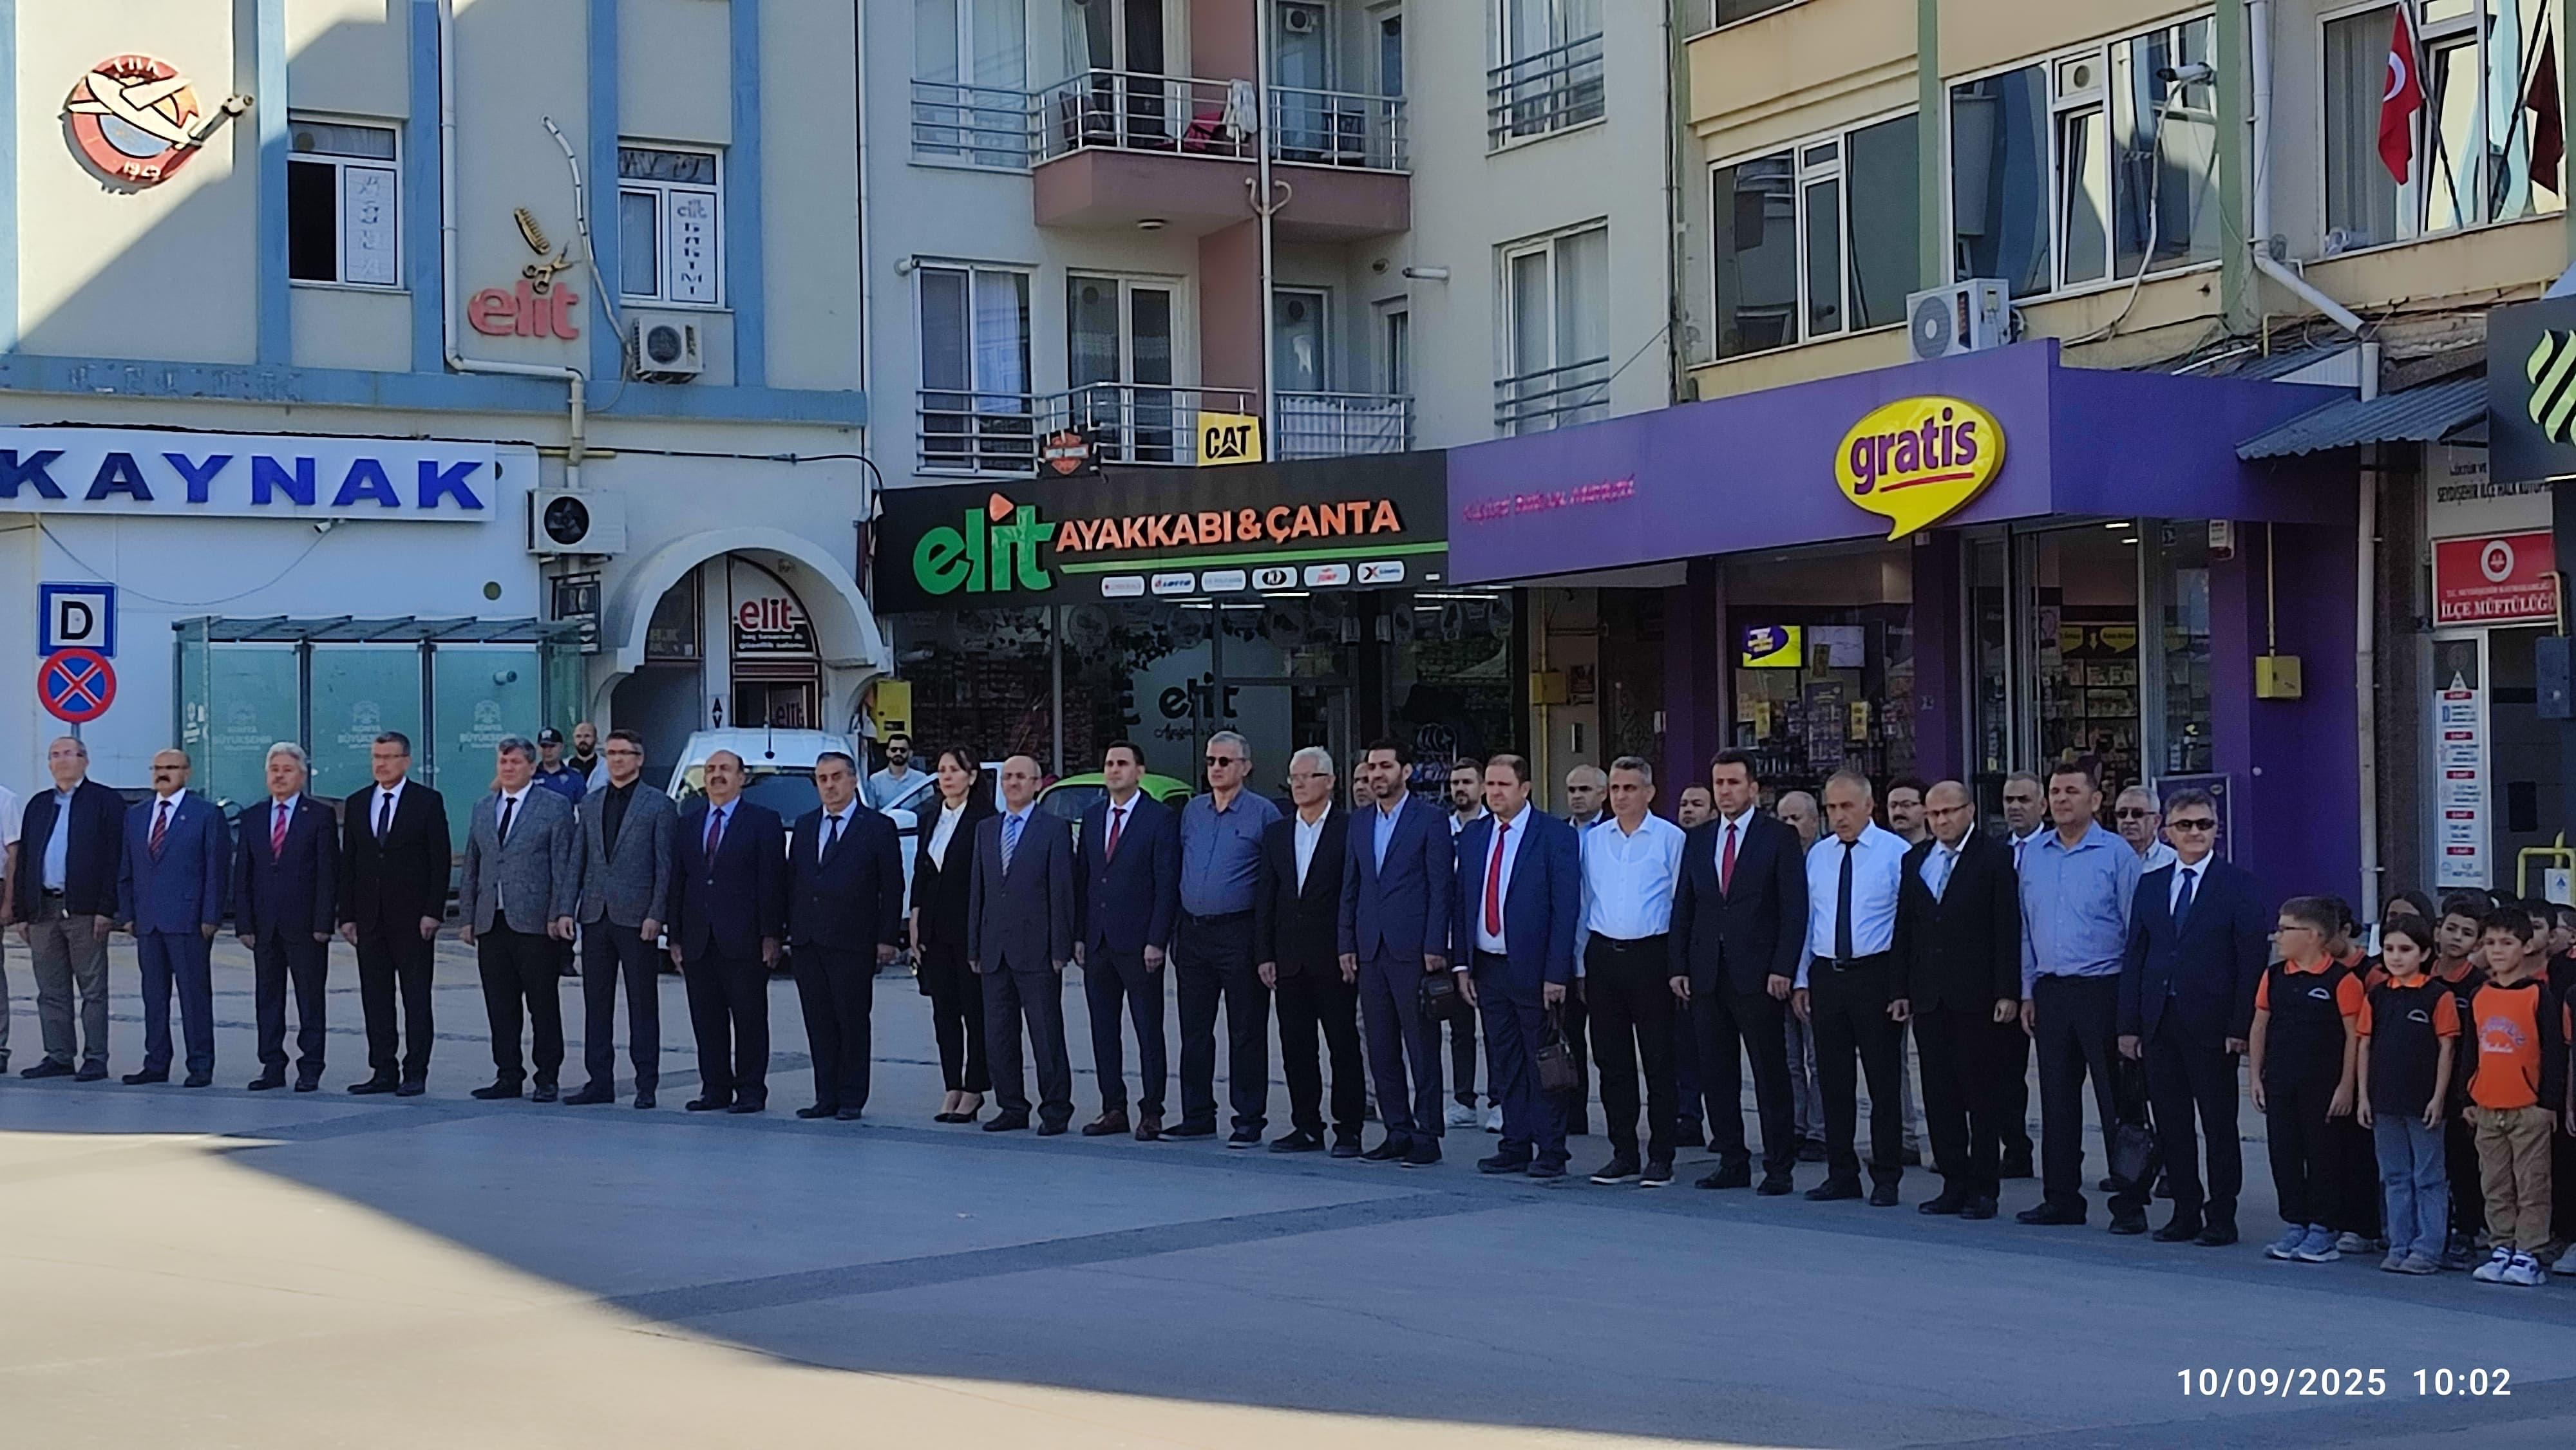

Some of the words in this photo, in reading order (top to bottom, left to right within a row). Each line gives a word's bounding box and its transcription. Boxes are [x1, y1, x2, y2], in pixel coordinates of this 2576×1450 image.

[468, 279, 578, 339] elit
[1206, 425, 1251, 458] CAT
[1850, 406, 1977, 495] gratis
[0, 449, 485, 510] KAYNAK
[913, 493, 1056, 595] elit
[59, 600, 94, 641] D
[739, 597, 793, 630] elit
[2441, 599, 2472, 620] İLÇE
